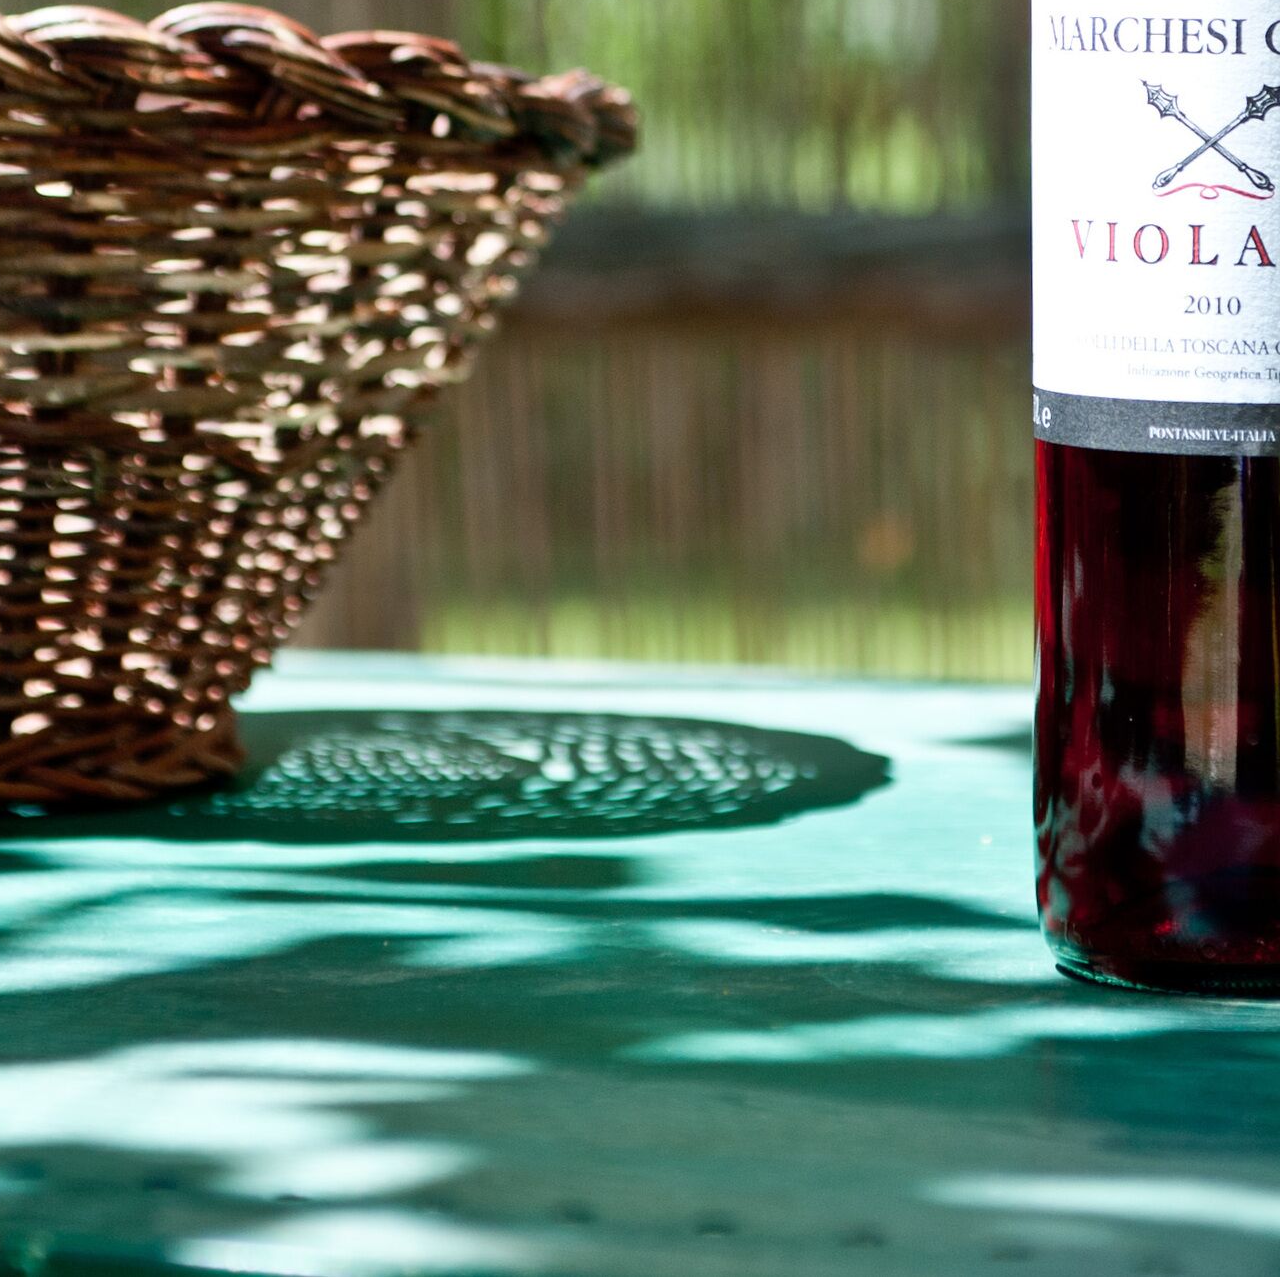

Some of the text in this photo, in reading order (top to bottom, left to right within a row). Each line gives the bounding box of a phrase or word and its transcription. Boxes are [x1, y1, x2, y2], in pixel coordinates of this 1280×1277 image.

[1049, 15, 1248, 57] MARCHESI
[1183, 295, 1243, 316] 2010
[1180, 337, 1270, 356] TOSCANA
[1194, 366, 1261, 383] Geografica
